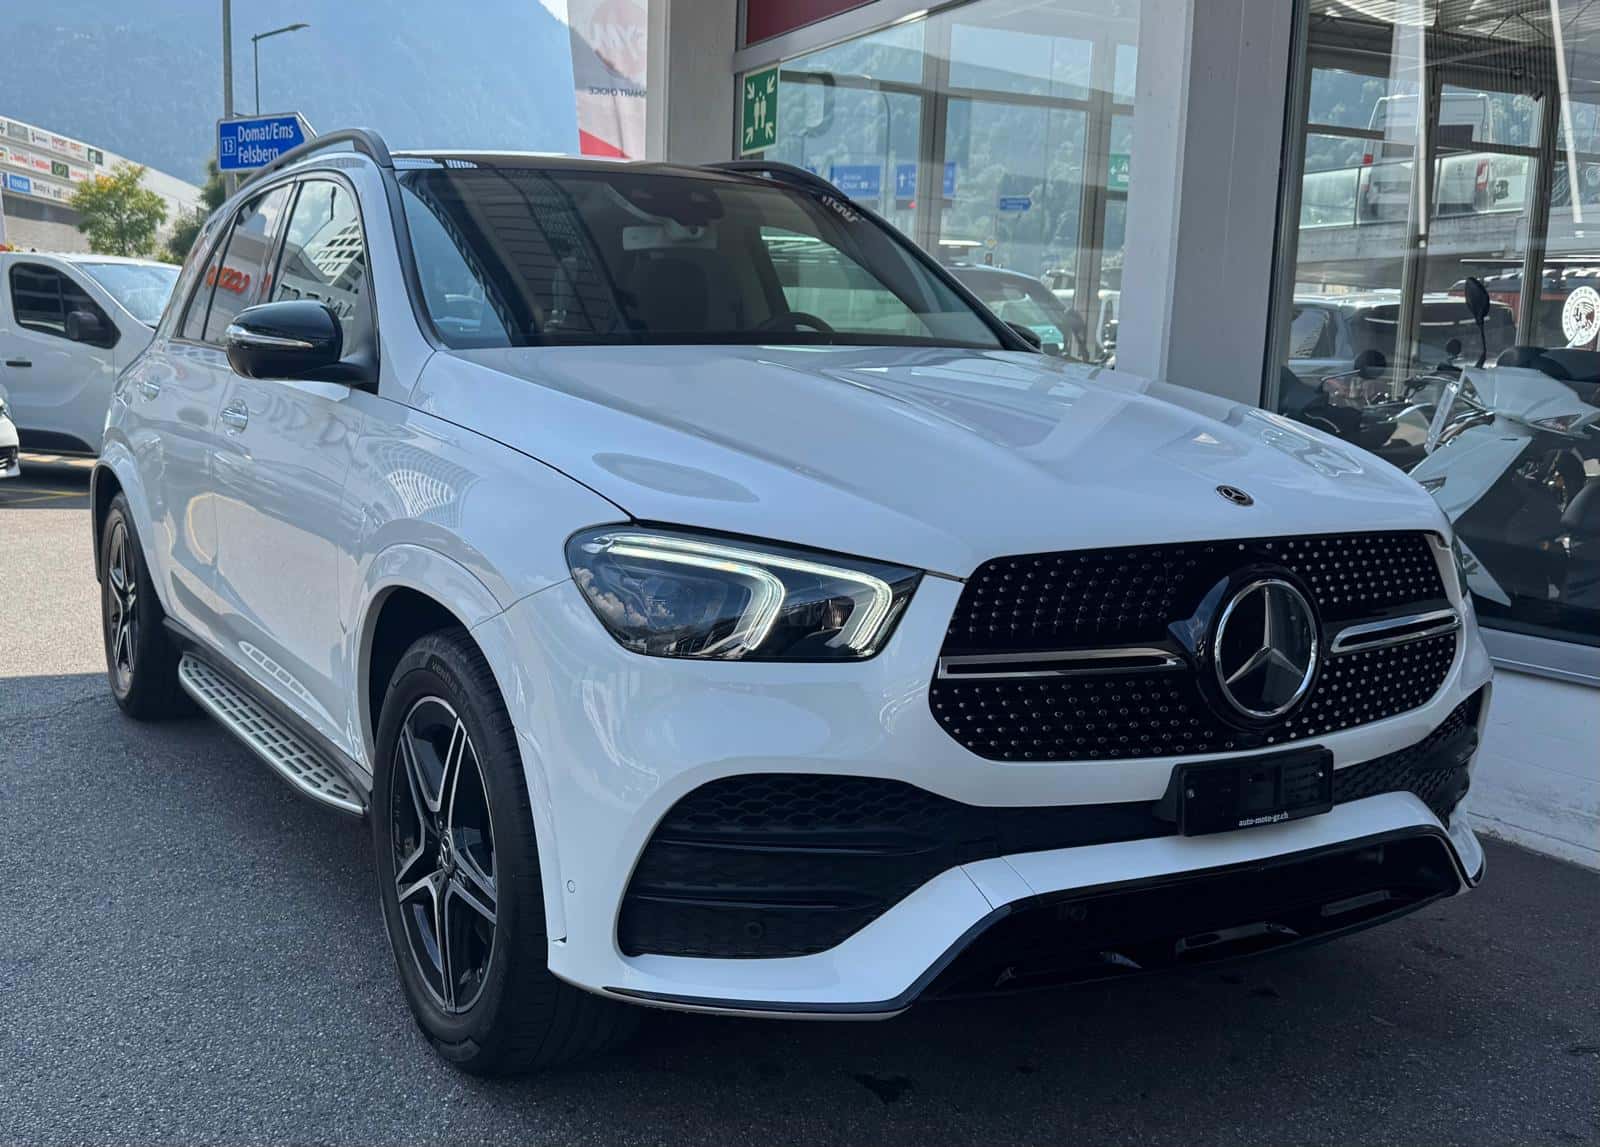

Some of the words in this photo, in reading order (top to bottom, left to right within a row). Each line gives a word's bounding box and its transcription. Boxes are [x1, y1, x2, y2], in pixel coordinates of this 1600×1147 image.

[238, 123, 294, 143] Domat/Ems
[224, 139, 234, 153] 13
[238, 145, 279, 164] Felsberg
